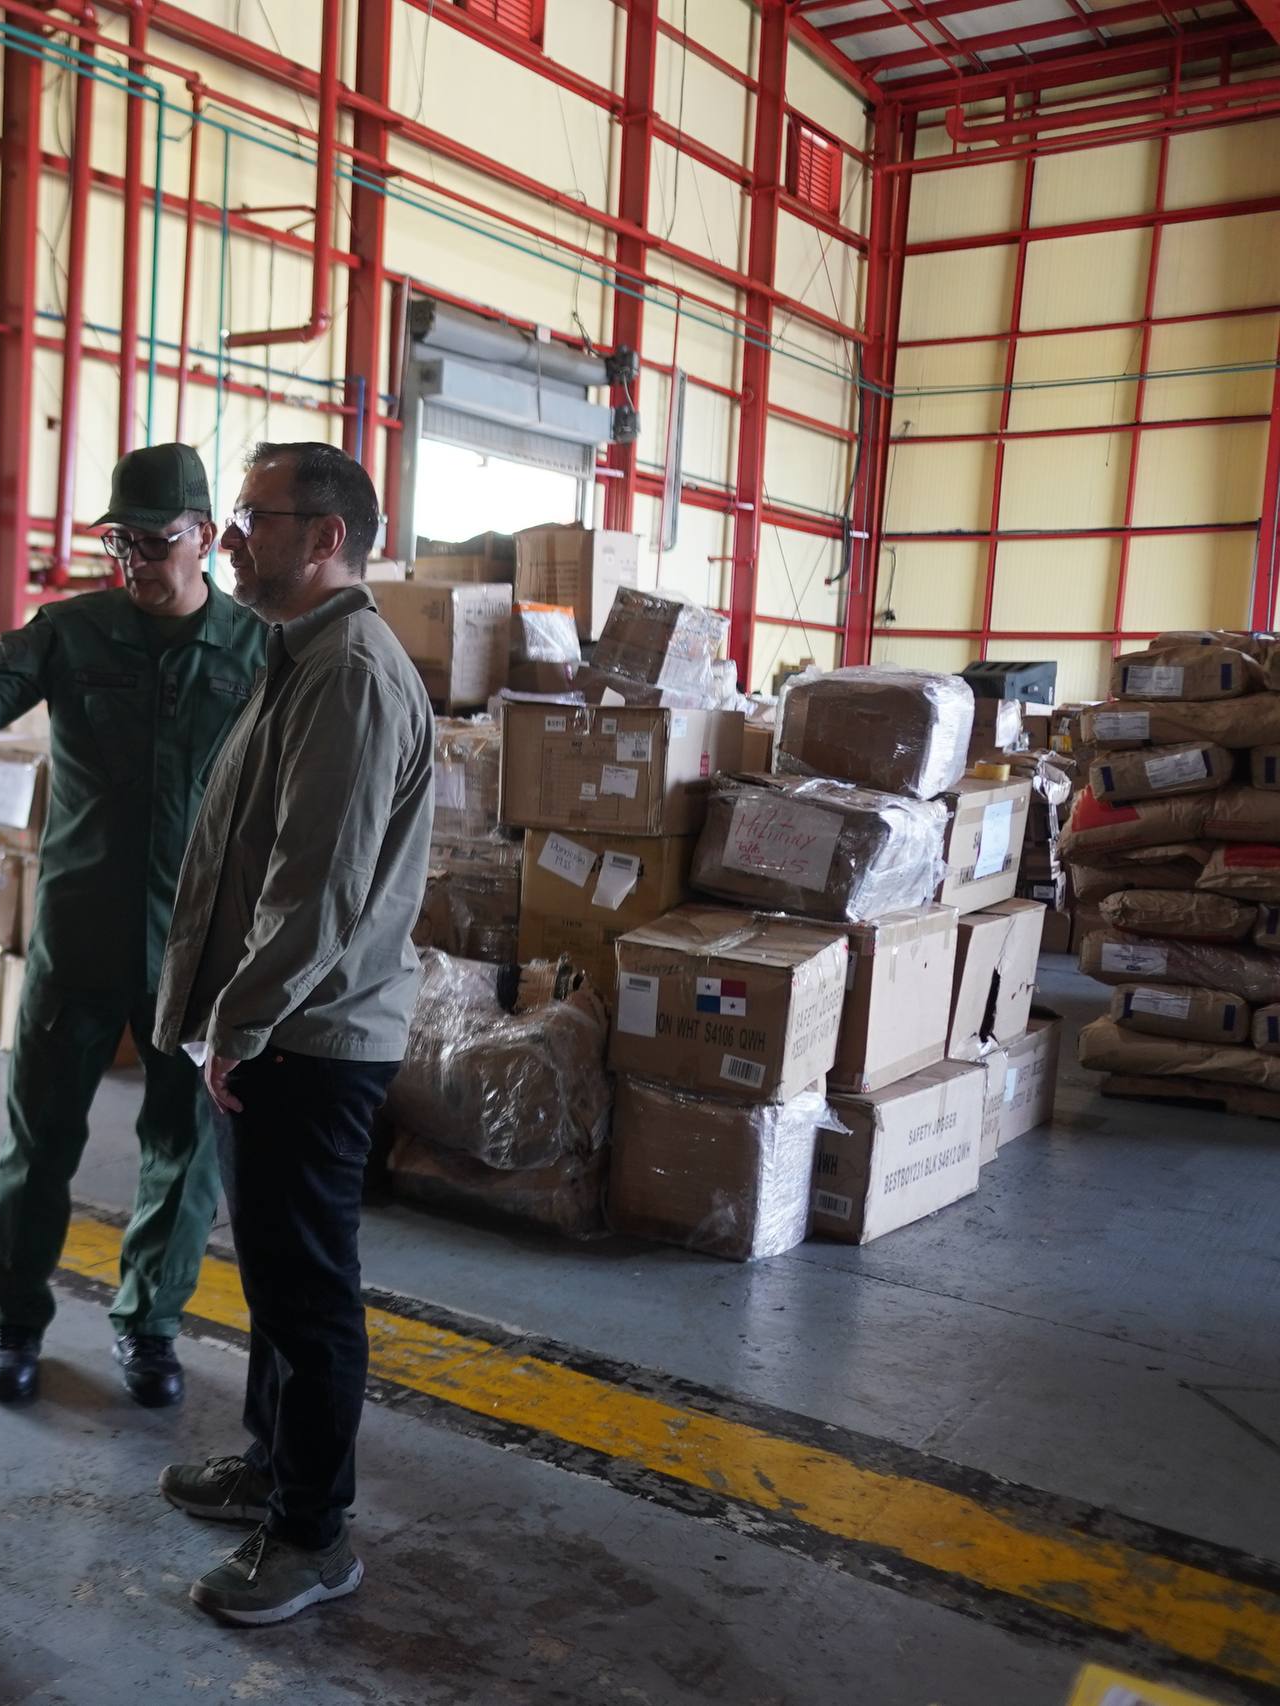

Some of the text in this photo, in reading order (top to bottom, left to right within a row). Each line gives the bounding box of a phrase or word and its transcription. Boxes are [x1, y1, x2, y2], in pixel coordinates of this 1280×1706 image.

[676, 1016, 701, 1040] WHT
[739, 1028, 767, 1053] QWH
[908, 1121, 932, 1146] SAFETY
[932, 1112, 957, 1136] JOGGER
